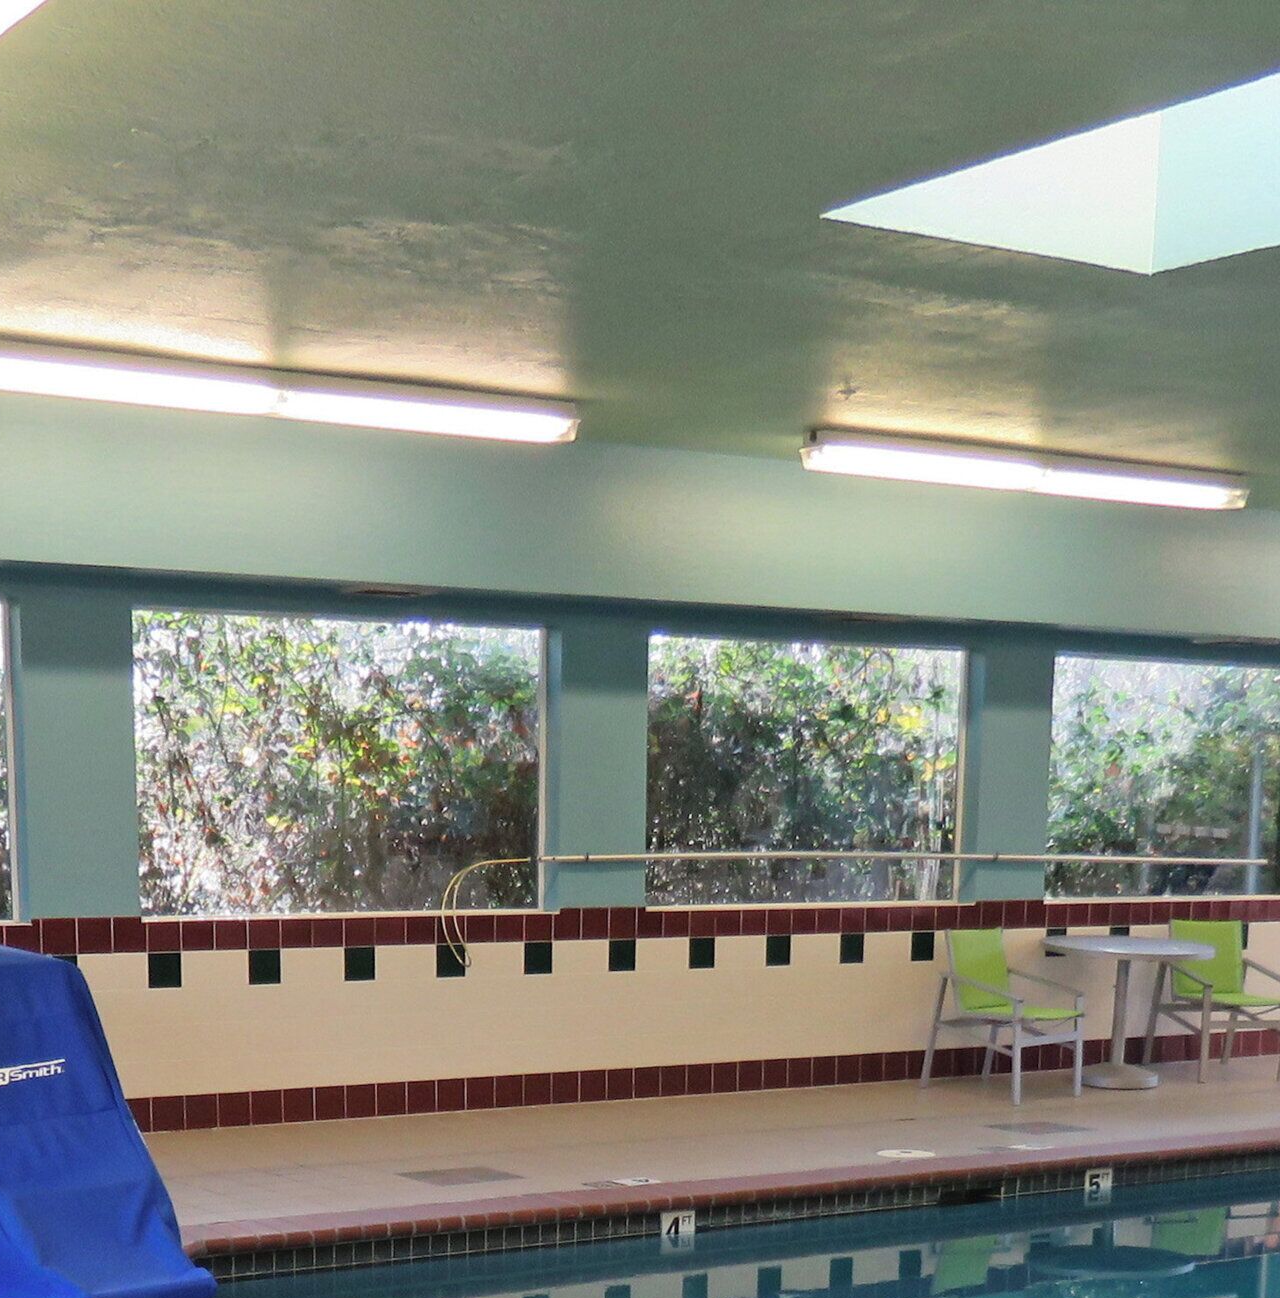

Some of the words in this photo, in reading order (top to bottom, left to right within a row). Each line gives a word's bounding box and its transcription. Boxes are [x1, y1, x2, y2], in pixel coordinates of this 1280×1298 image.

[9, 1064, 62, 1082] Smith
[1088, 1173, 1101, 1193] 5
[681, 1215, 693, 1226] FT
